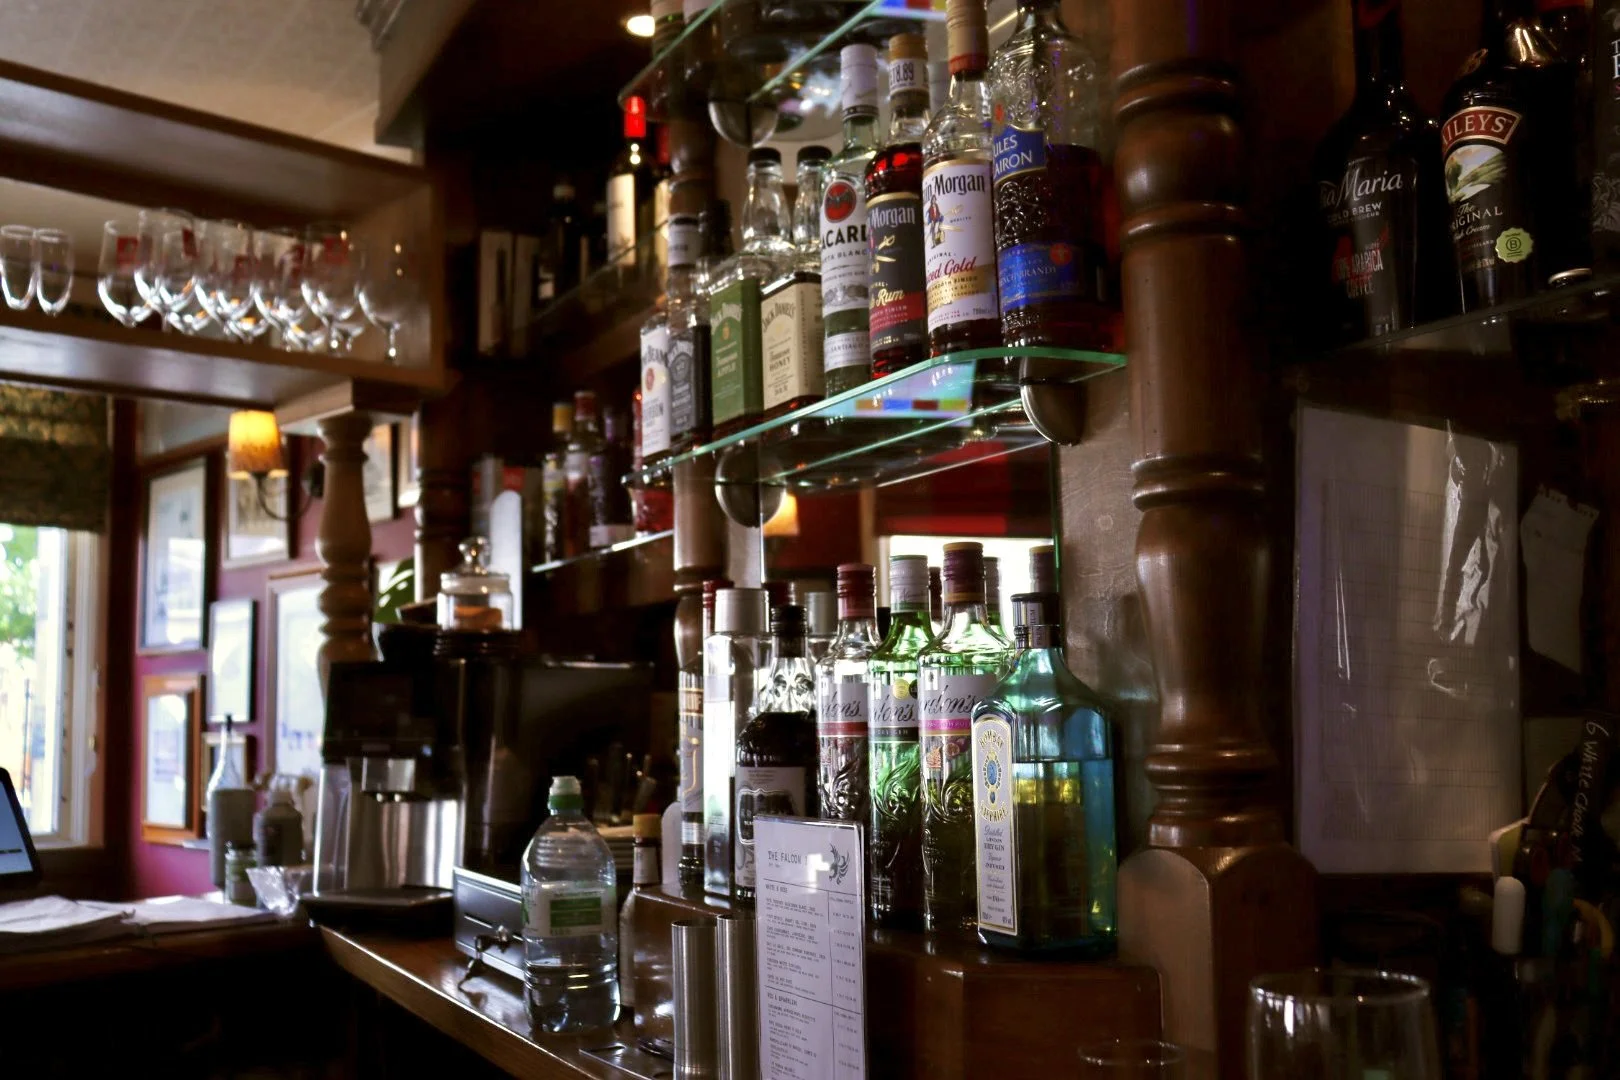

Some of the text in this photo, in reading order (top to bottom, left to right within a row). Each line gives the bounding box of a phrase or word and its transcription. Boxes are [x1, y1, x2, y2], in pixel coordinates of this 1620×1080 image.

[890, 62, 914, 86] 18.89
[1442, 114, 1508, 145] ILEYS
[992, 134, 1018, 158] ULES
[992, 150, 1033, 179] AIRON
[935, 174, 985, 196] Morgan
[1337, 167, 1402, 208] Maria
[871, 206, 915, 228] Morgan
[1352, 201, 1381, 215] BREW
[1450, 205, 1503, 231] RIGINAL
[821, 225, 867, 249] ACAR
[944, 256, 977, 277] Gold
[876, 288, 904, 307] Rum
[769, 356, 790, 372] HONEY
[924, 684, 977, 715] rdon's
[1585, 720, 1610, 739] 6
[1578, 740, 1601, 789] White
[1571, 792, 1590, 838] Chalk
[767, 850, 778, 861] THE
[780, 852, 802, 865] FALCON
[995, 843, 1005, 852] GIN
